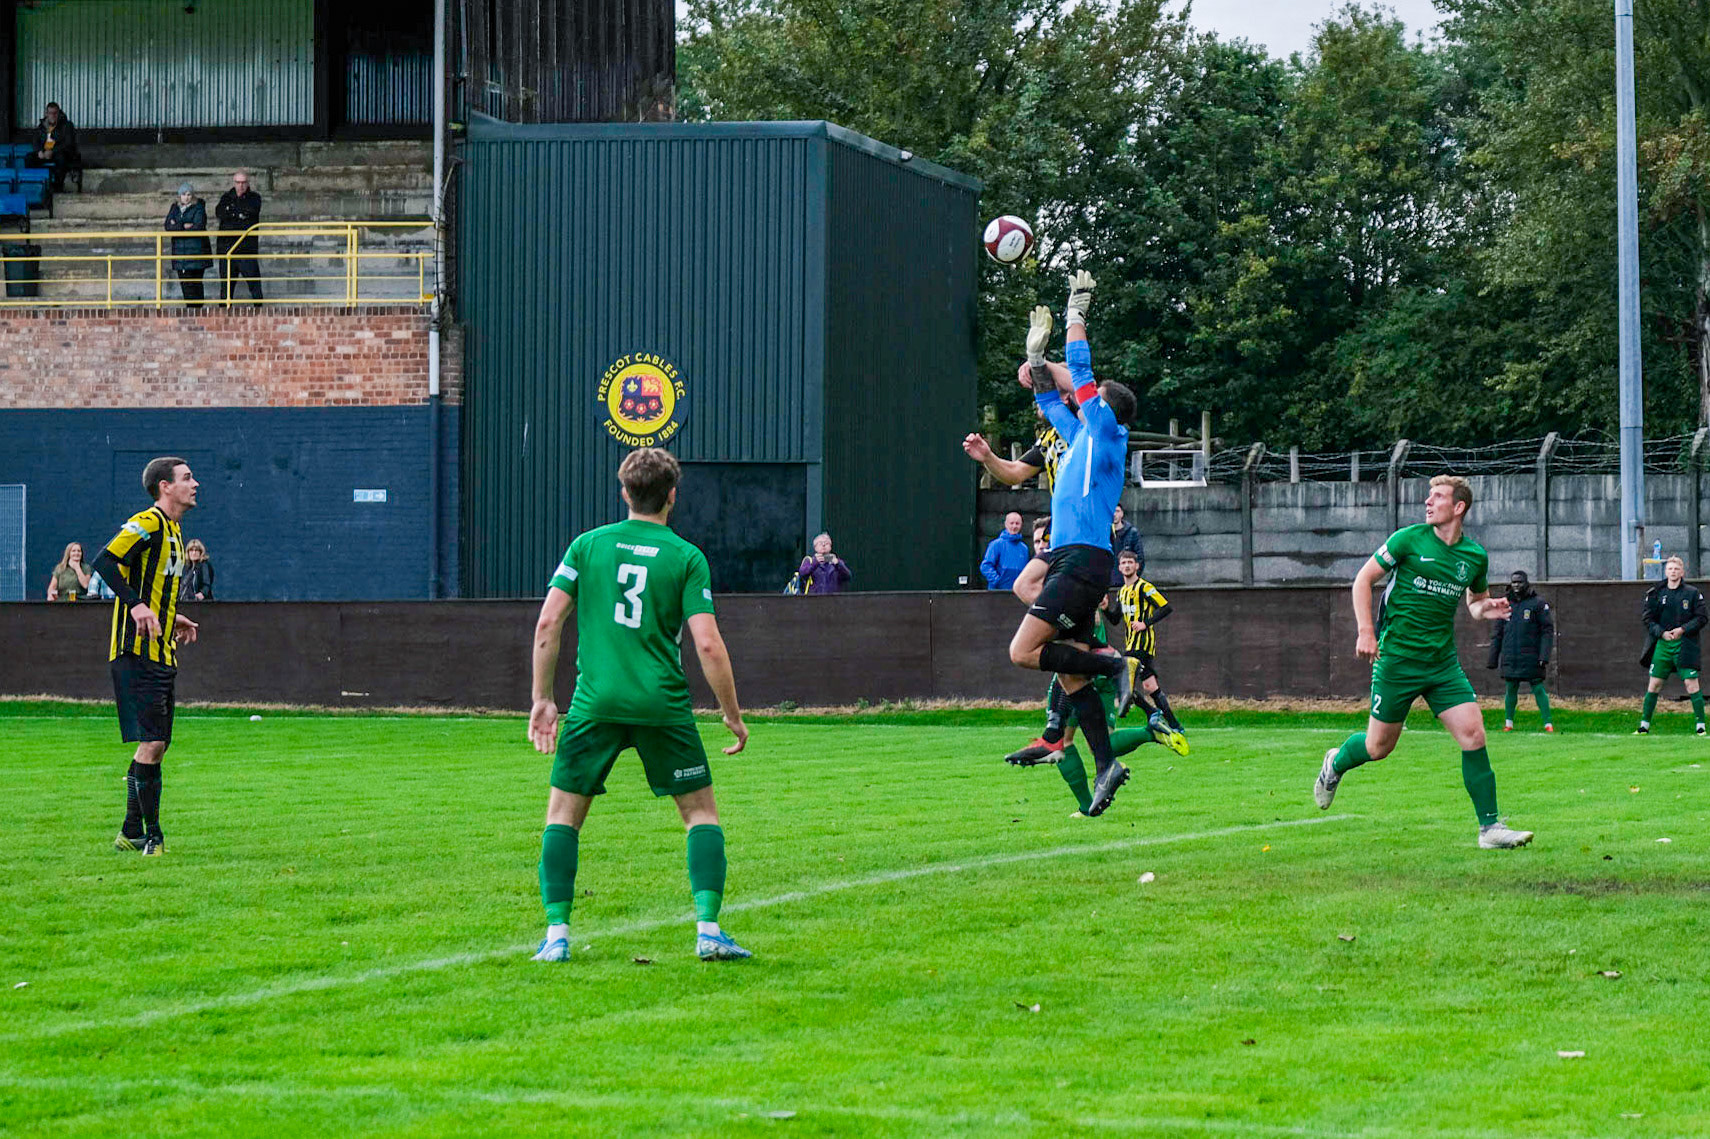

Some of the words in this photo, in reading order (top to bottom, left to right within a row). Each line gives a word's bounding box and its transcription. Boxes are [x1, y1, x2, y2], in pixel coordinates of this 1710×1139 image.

[597, 354, 631, 402] PRESCOT
[635, 352, 678, 379] CABLES
[603, 419, 655, 447] FOUNDED
[658, 420, 679, 442] 1884
[614, 562, 648, 628] 3
[1372, 694, 1382, 715] 2
